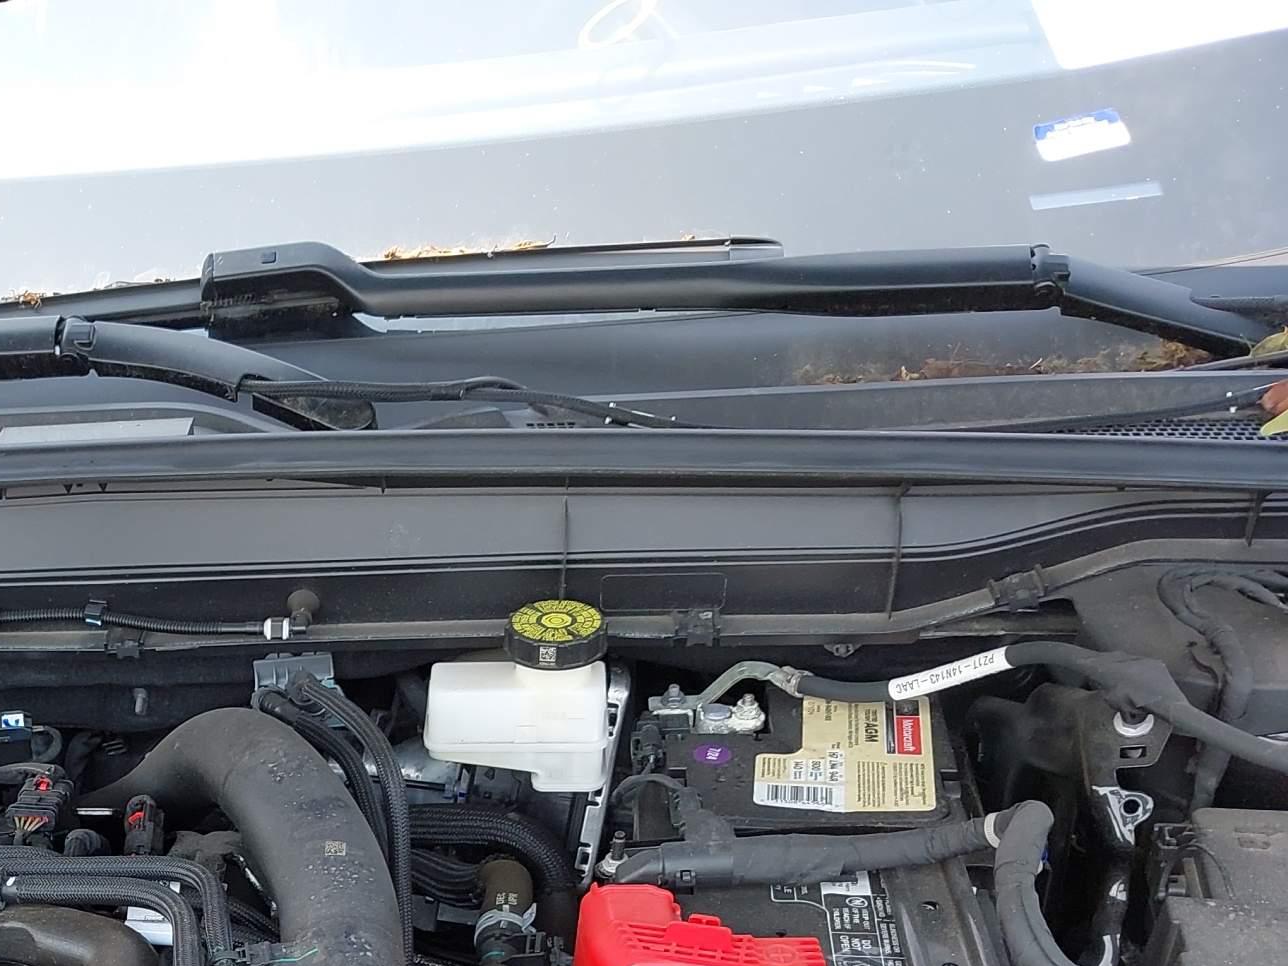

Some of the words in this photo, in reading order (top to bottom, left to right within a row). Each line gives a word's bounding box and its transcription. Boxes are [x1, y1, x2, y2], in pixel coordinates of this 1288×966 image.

[864, 722, 879, 742] AGM
[901, 719, 917, 752] Motorcraft
[840, 936, 849, 952] OPEN
[851, 939, 860, 951] NOT
[863, 940, 871, 948] DO
